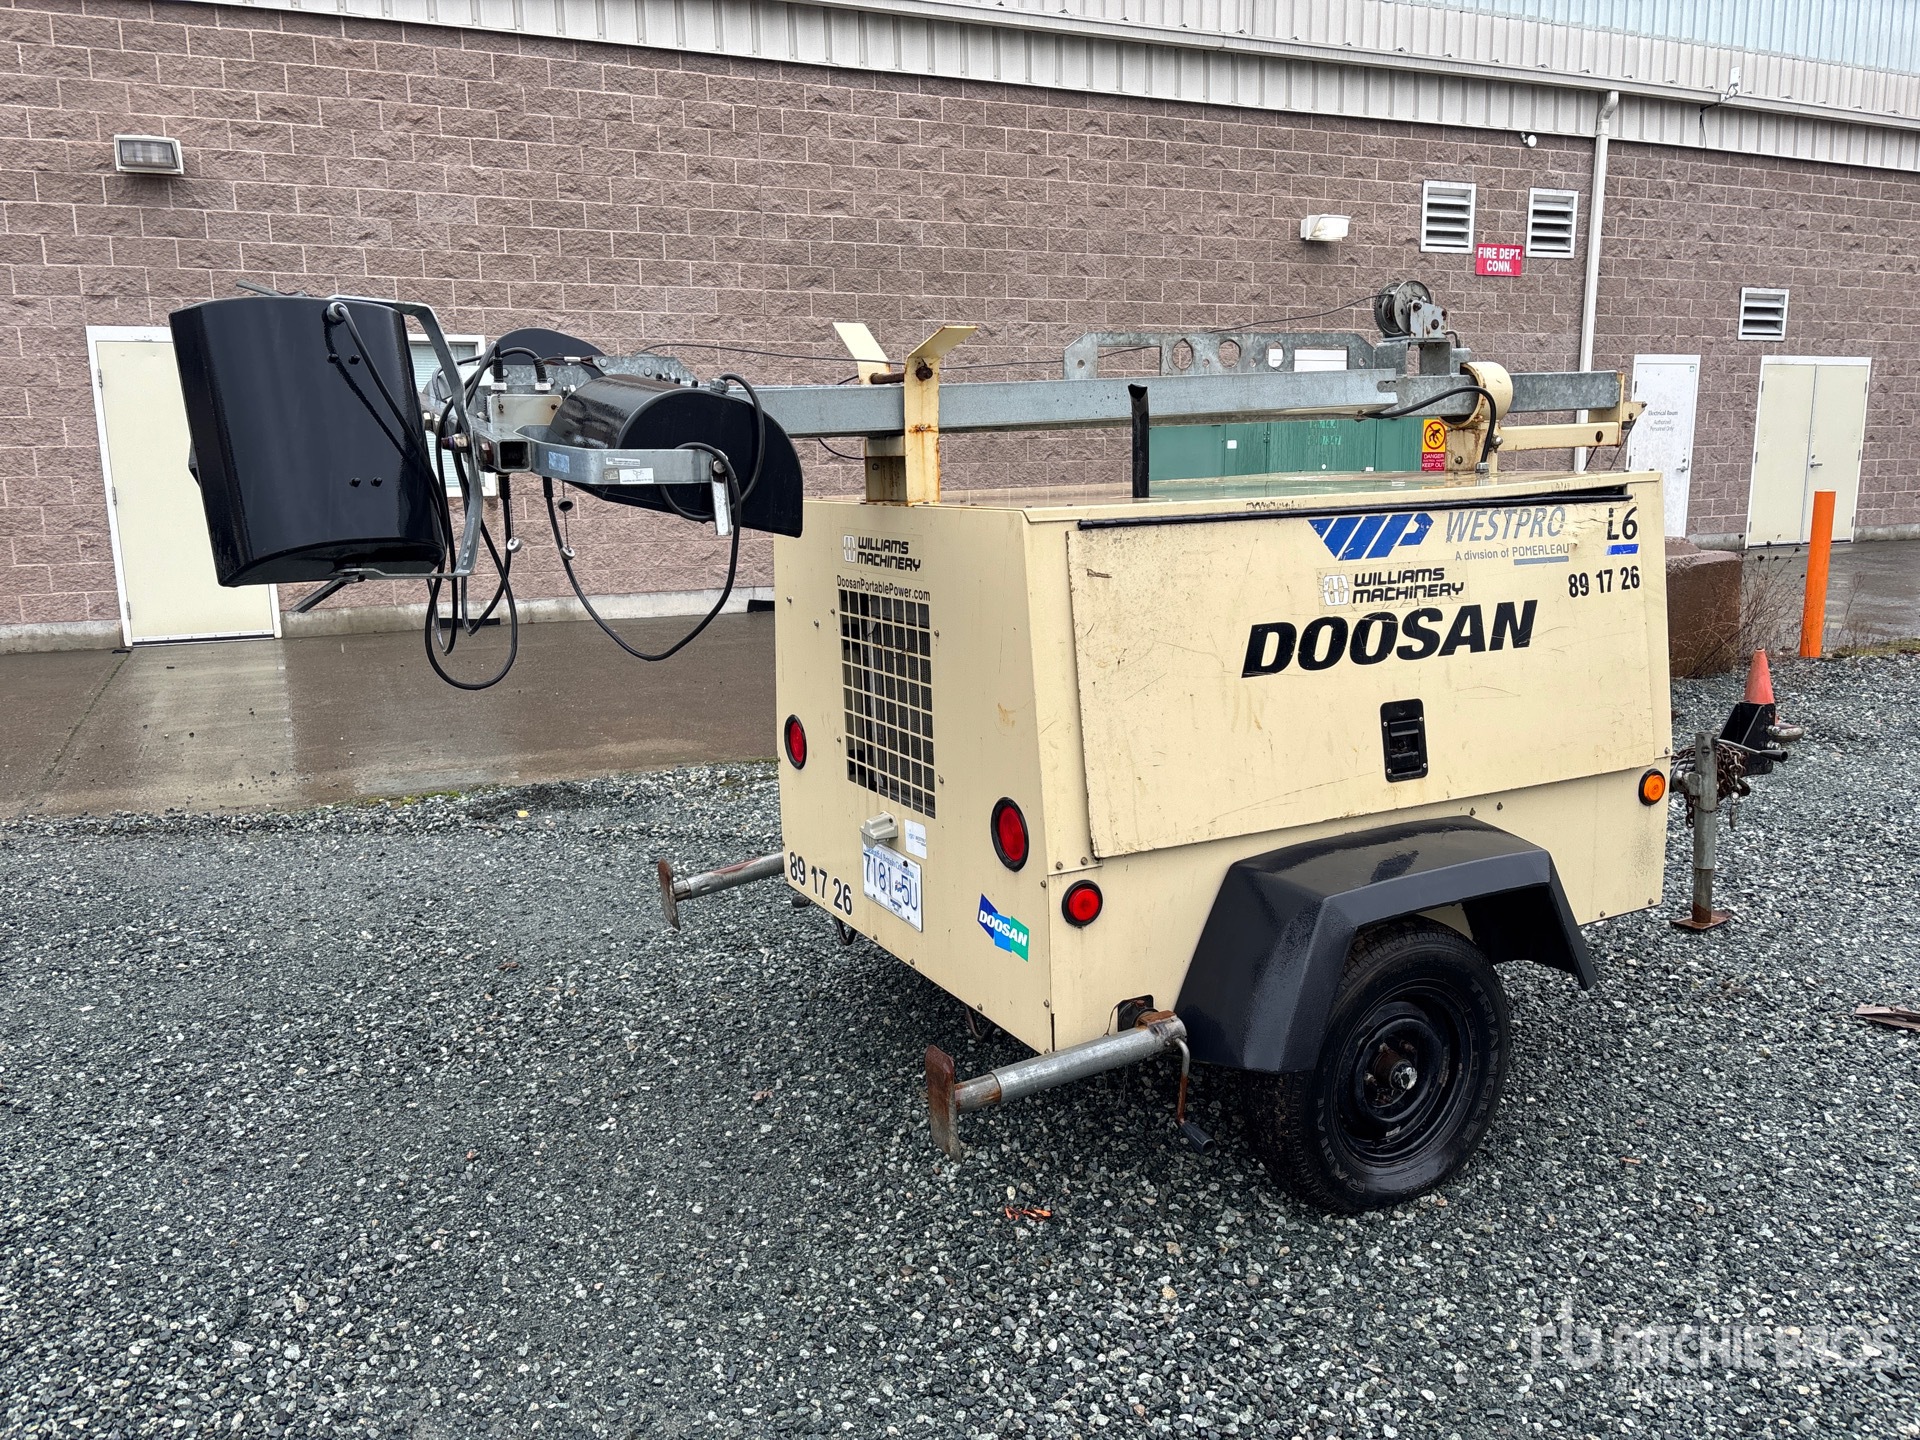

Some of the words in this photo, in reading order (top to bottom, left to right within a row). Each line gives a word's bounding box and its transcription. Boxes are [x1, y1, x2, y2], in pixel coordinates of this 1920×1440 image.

[1478, 247, 1498, 259] FIRE
[1499, 248, 1521, 260] DEPT.
[1486, 260, 1513, 272] CONN.
[1446, 506, 1566, 543] WESTPRO
[1607, 506, 1638, 540] L6
[857, 551, 921, 572] MACHINERY
[858, 536, 909, 555] WILLIAMS
[1455, 551, 1462, 561] A
[1464, 550, 1498, 560] division
[1501, 548, 1509, 558] of
[1512, 543, 1570, 557] POMERLEAU
[837, 574, 931, 602] DoosanPortablePower.com
[1352, 582, 1464, 604] MACHINERY
[1354, 567, 1445, 587] WILLIAMS
[1568, 572, 1589, 598] 89
[1596, 568, 1613, 594] 17
[1620, 565, 1640, 590] 26
[1241, 599, 1538, 679] DOOSAN
[790, 851, 806, 886] 89
[811, 865, 828, 899] 17
[833, 877, 853, 916] 26
[863, 852, 892, 897] 7181
[979, 909, 1028, 947] DOOSAN
[1463, 978, 1499, 1142] TRIANGLE
[1317, 1098, 1366, 1193] RADIAL
